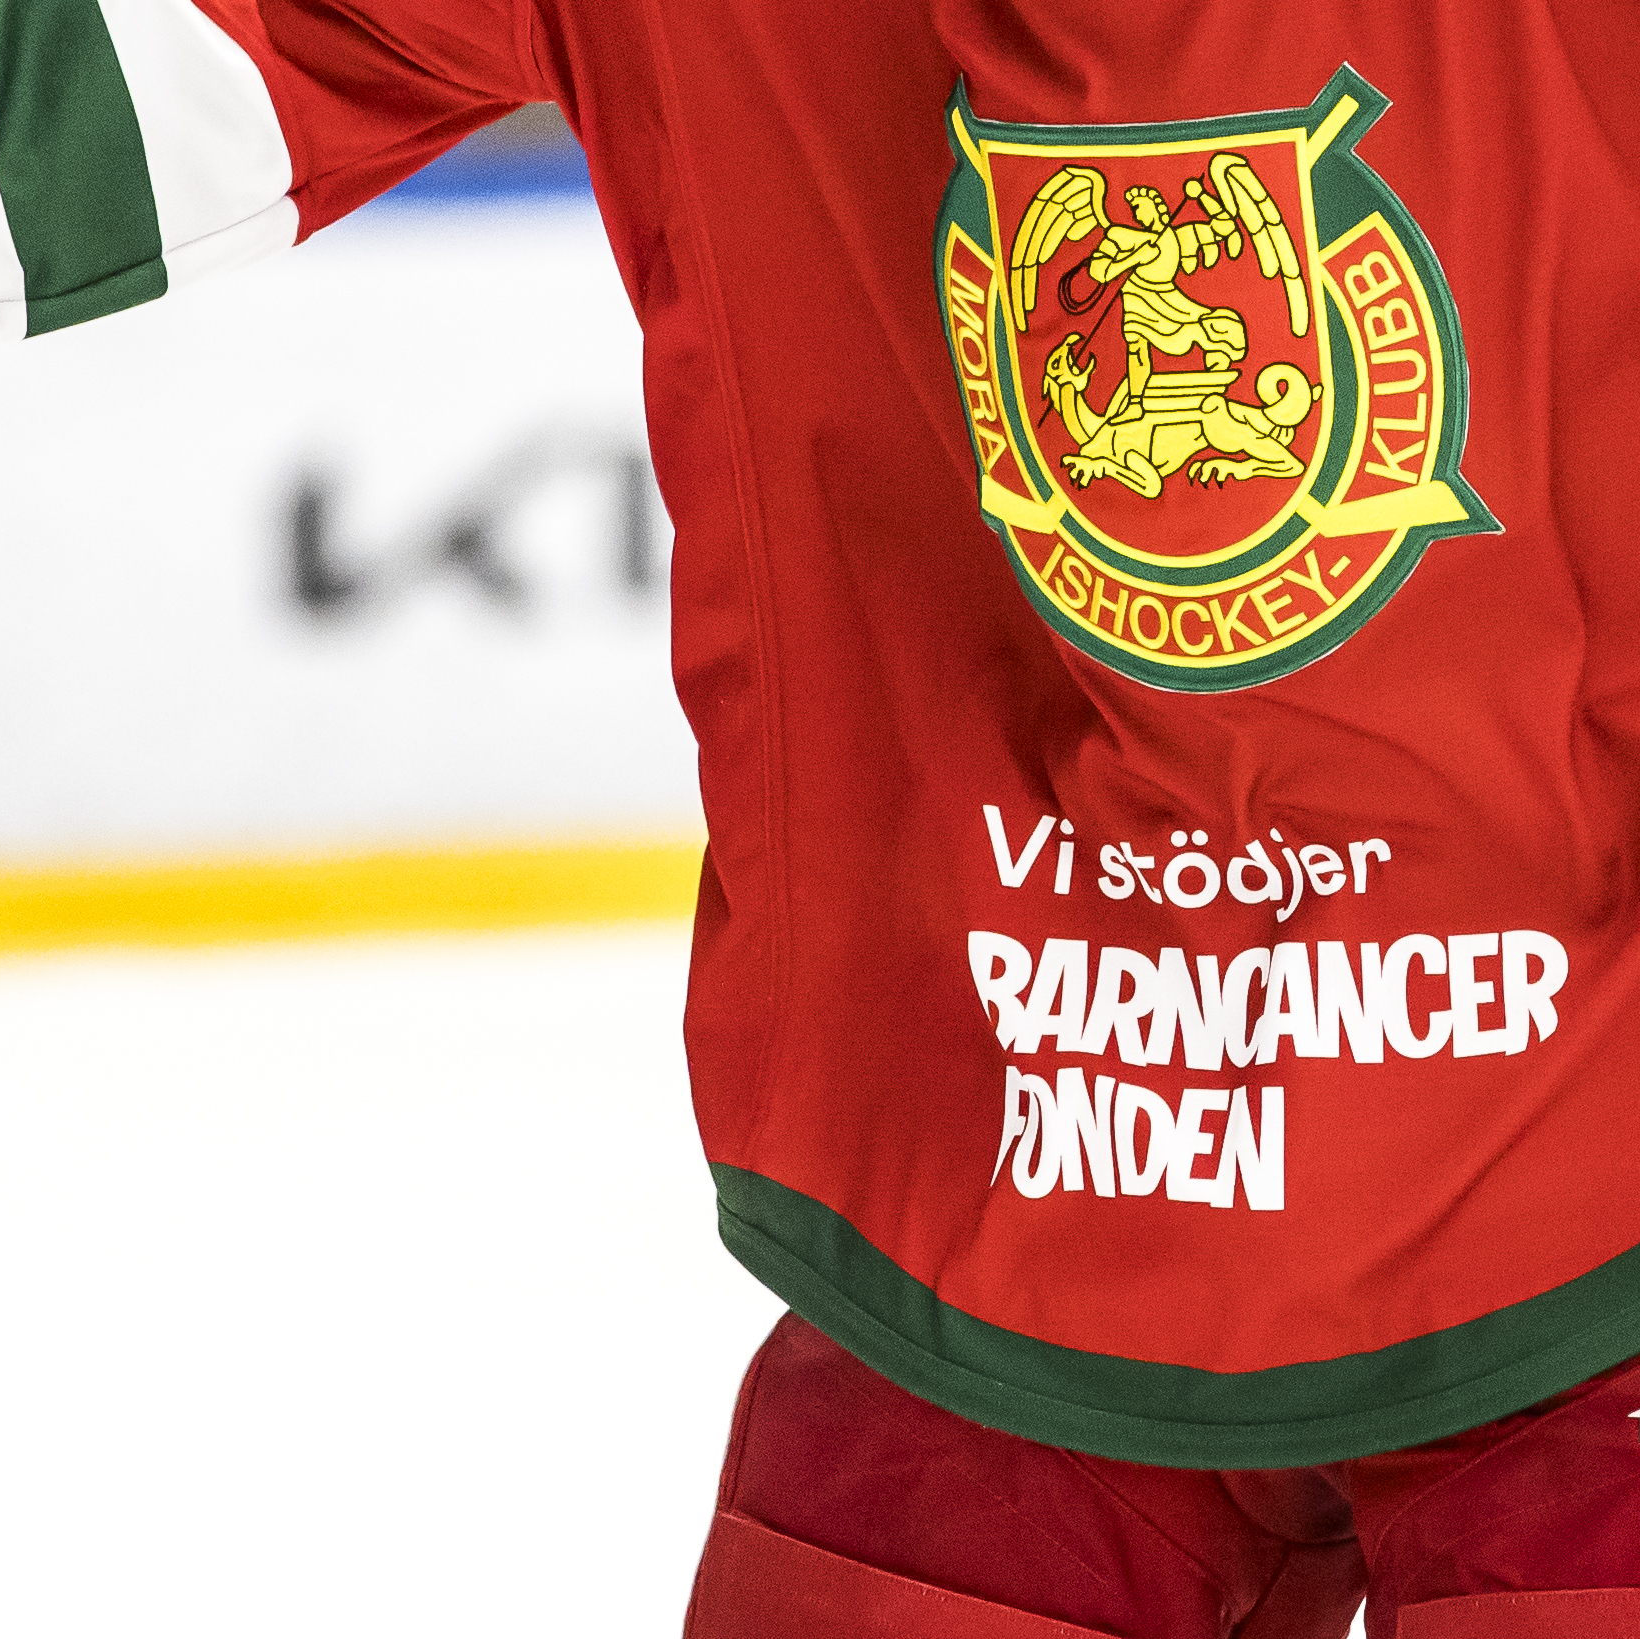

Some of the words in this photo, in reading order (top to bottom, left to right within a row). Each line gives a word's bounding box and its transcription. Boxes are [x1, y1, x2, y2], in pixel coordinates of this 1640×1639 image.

[950, 268, 1006, 478] MORA
[1344, 247, 1427, 484] KLUBB
[1039, 541, 1352, 655] ISHOCKEY-
[982, 804, 1075, 895] Vi
[1097, 827, 1392, 923] stödjer
[967, 929, 1569, 1071] BARNCANCER
[990, 1065, 1285, 1211] FONDEN
